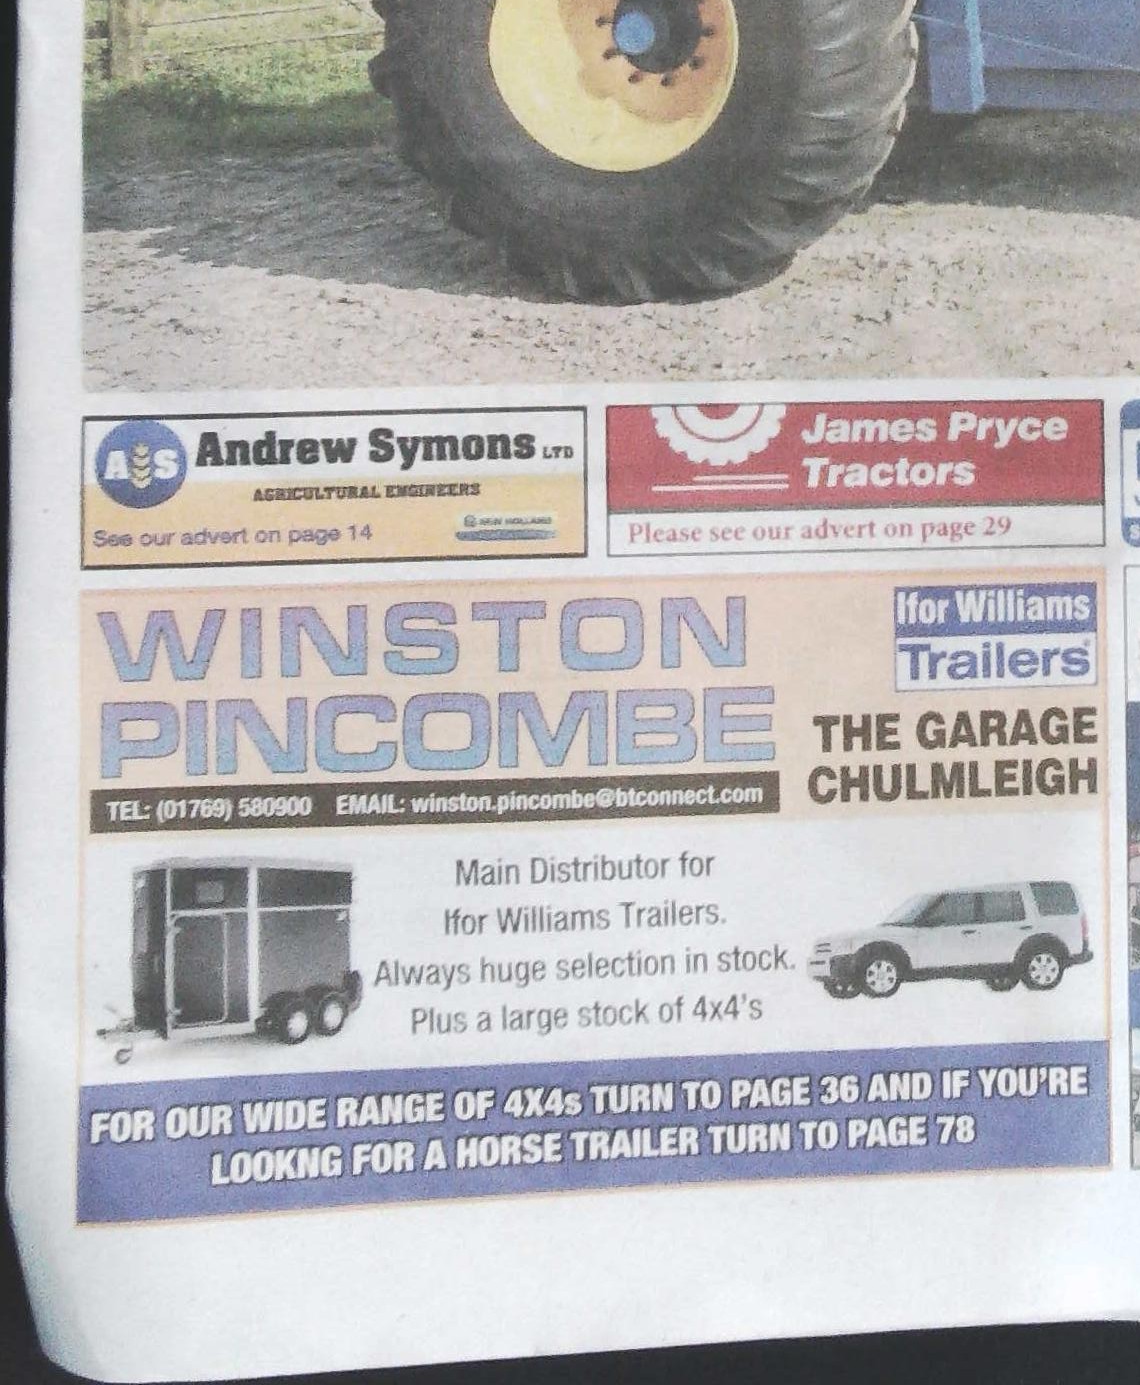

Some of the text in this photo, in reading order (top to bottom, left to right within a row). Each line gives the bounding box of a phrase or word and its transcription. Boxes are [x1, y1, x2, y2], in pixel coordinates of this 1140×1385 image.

[195, 427, 574, 471] Andrew Symons LTD
[801, 409, 1070, 449] James Pryce
[801, 456, 976, 489] Tractors
[628, 516, 1012, 545] Please see our advert on page 29
[896, 587, 1091, 626] Ifor Williams
[96, 595, 748, 682] WINSTON
[897, 641, 1091, 681] Trailers
[99, 686, 777, 779] PINCOMBE
[812, 706, 1098, 753] THE GARAGE
[807, 757, 1098, 805] CHULMLEIGH
[105, 784, 764, 824] TEL: (01769) 580900 EMAIL: winston.pincombe@btconnect.com
[455, 851, 716, 887] Main Distributor for
[443, 899, 727, 936] Ifor Williams Trailers.
[373, 943, 797, 991] Always huge selection in stock.
[410, 992, 764, 1036] Plus a large stock of 4x4's
[89, 1065, 1090, 1145] FOR OUR WIDE RANGE OF 4X4s TURN TO PAGE 36 AND IF YOU'RE
[351, 1140, 415, 1178] FOR
[423, 1139, 447, 1172] A
[454, 1131, 564, 1169] HORSE
[569, 1121, 700, 1163] TRAILER
[706, 1121, 792, 1156] TURN
[797, 1118, 839, 1151] TO
[847, 1115, 929, 1150] PAGE
[935, 1113, 977, 1146] 78
